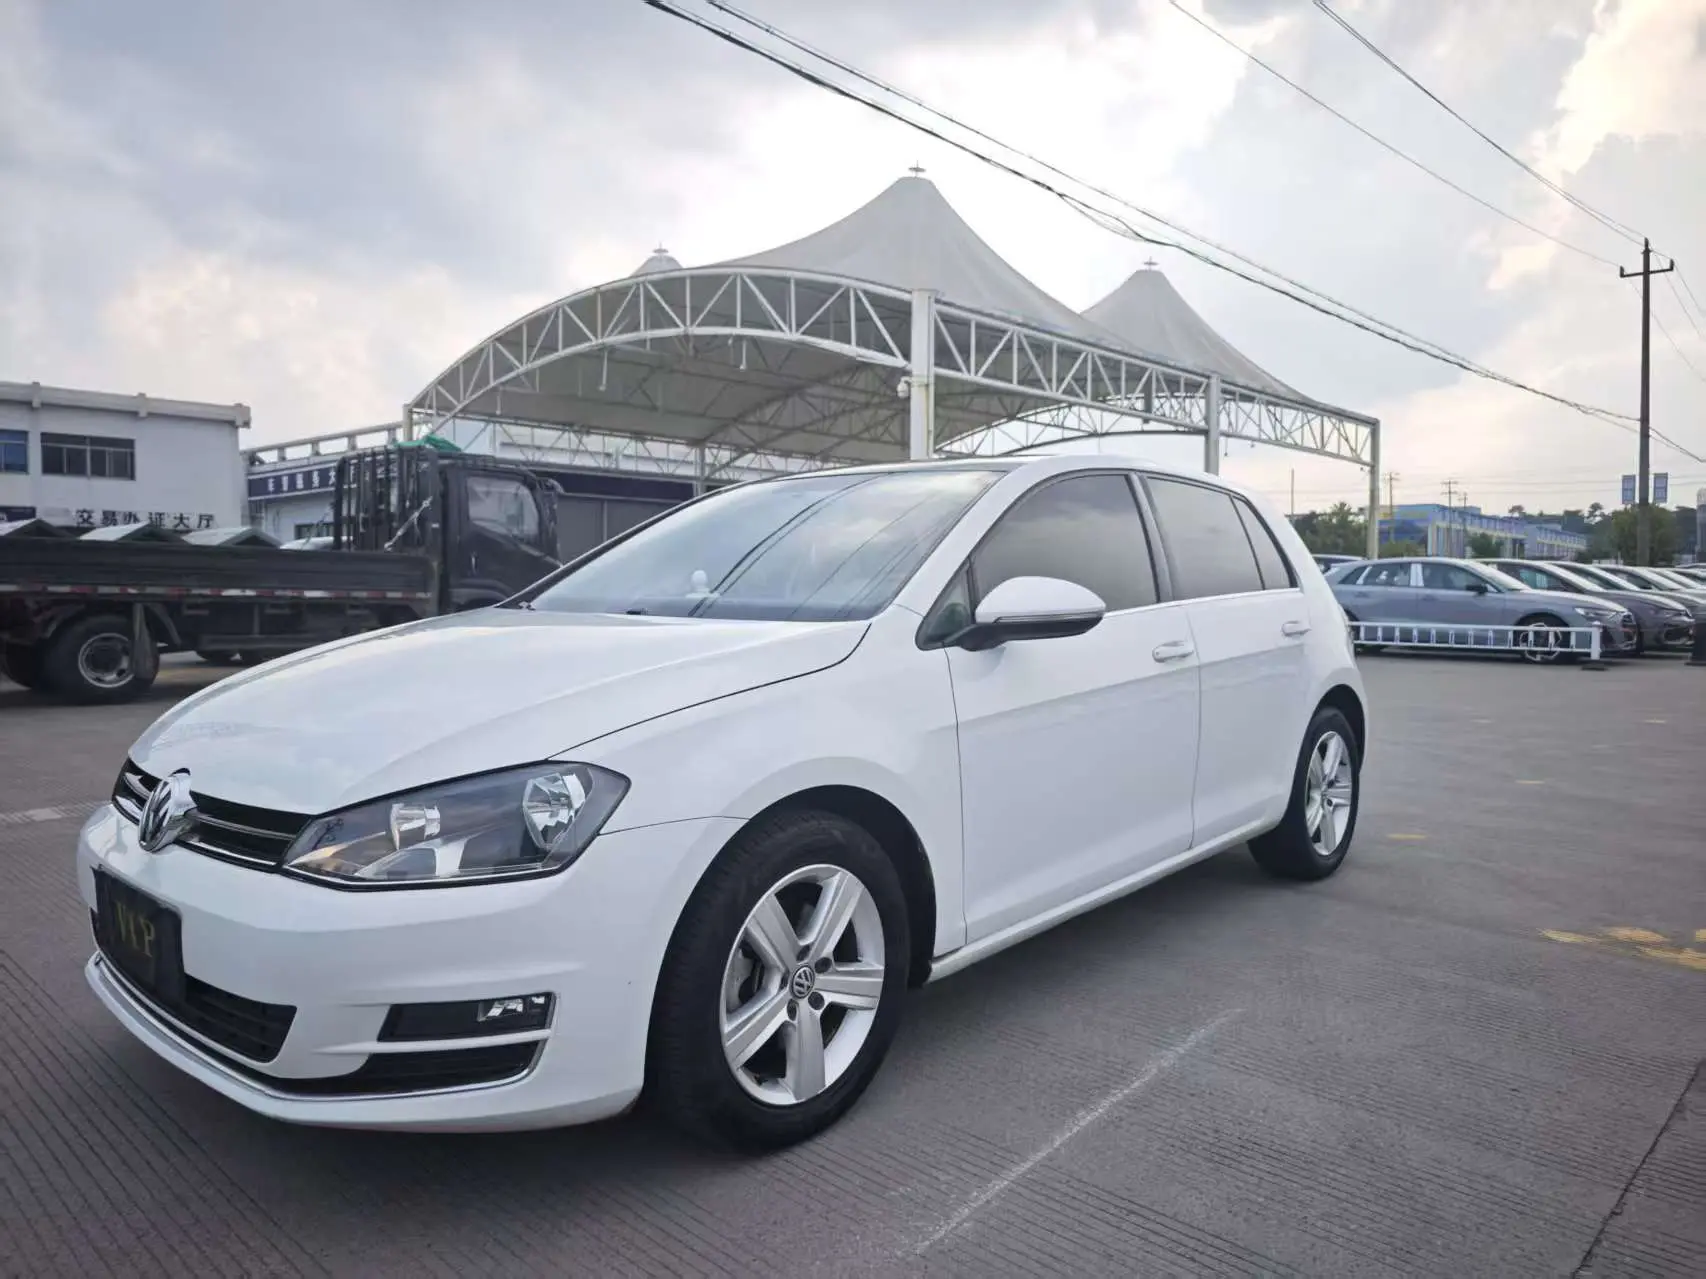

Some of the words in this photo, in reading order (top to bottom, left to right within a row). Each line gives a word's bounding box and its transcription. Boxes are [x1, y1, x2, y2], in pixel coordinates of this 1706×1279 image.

[76, 508, 215, 529] 交易办证大厅
